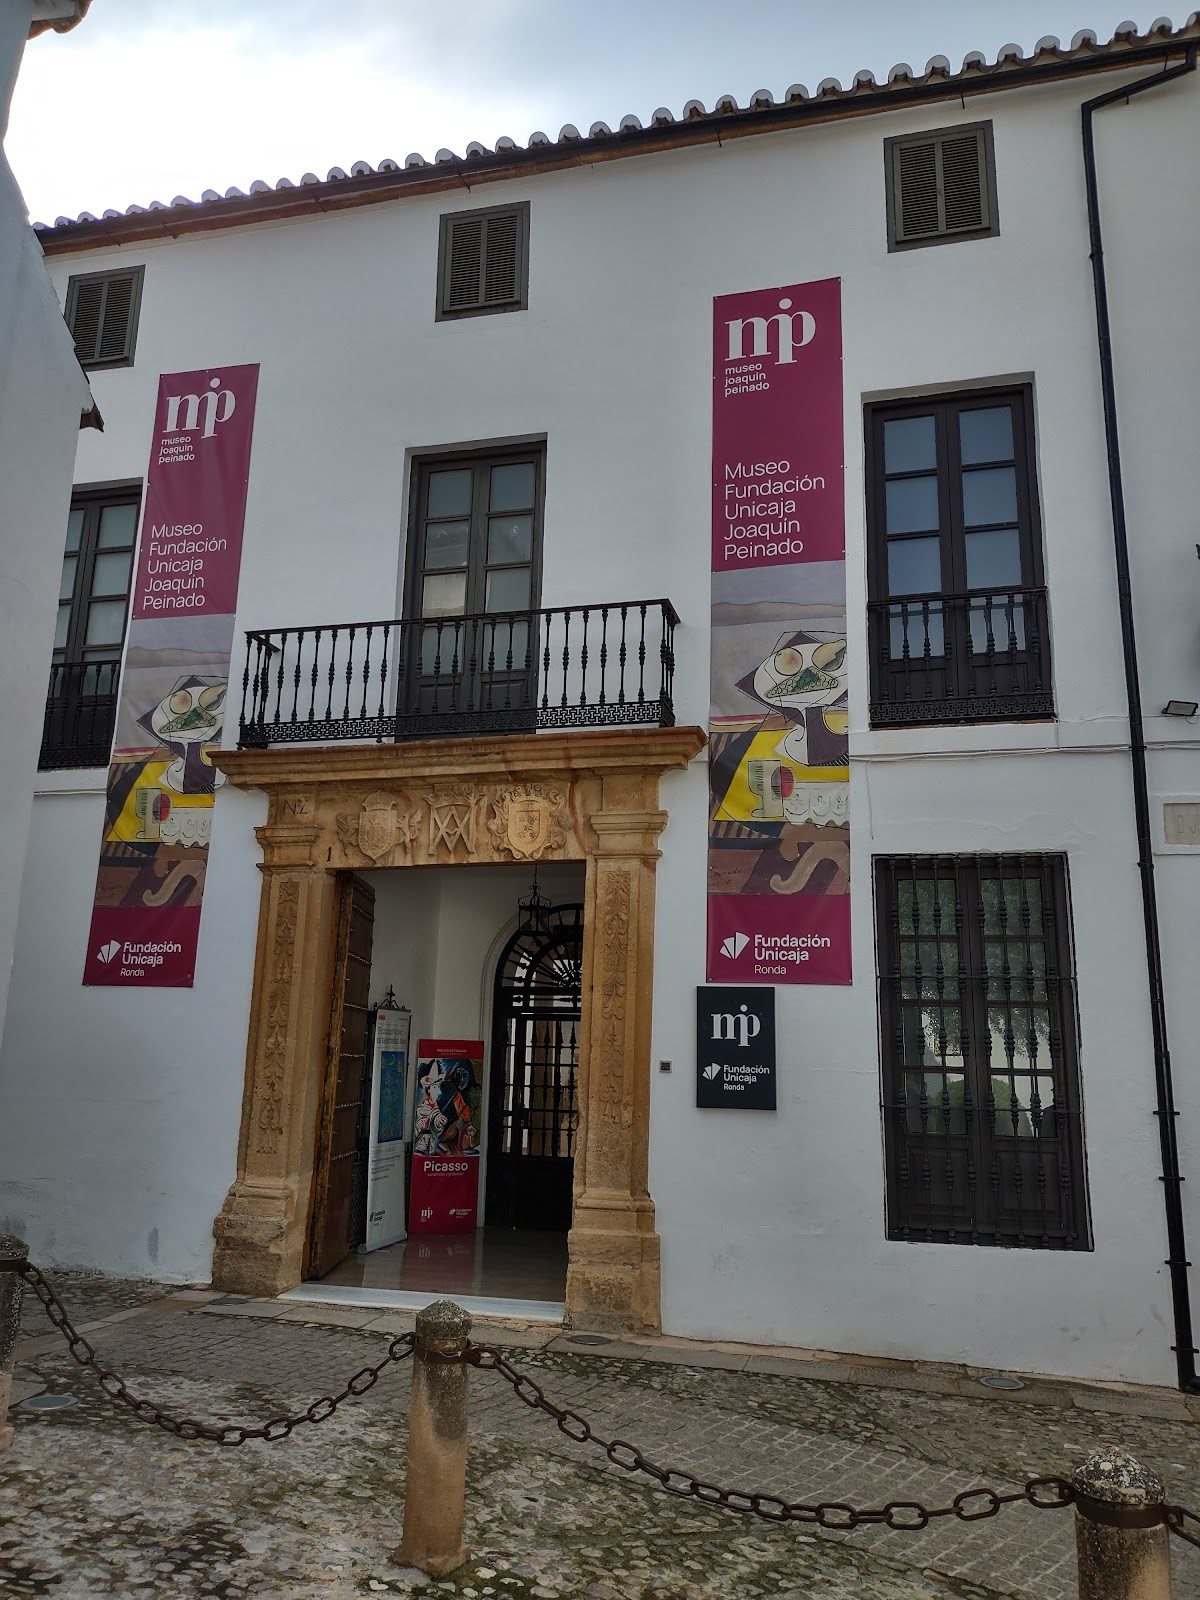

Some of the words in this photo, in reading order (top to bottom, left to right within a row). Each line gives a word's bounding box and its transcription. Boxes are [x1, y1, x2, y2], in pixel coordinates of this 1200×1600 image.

[725, 363, 763, 375] museo
[725, 381, 770, 398] peinado
[161, 436, 191, 446] museo
[158, 453, 195, 465] peinado
[725, 460, 790, 481] Museo
[725, 475, 825, 500] Fundación
[725, 497, 796, 520] Unicaja
[151, 523, 203, 539] Museo
[723, 517, 800, 541] Joaquín
[149, 537, 227, 557] Fundación
[724, 538, 804, 561] Peinado
[147, 556, 204, 575] Unicaja
[144, 574, 205, 594] Joaquín
[142, 592, 206, 611] Peinado
[123, 941, 182, 953] Fundación
[754, 934, 831, 948] Fundación
[122, 953, 164, 968] Unicaja
[754, 948, 810, 965] Unicaja
[120, 967, 145, 977] Ronda
[754, 964, 787, 975] Ronda
[723, 1064, 770, 1075] Fundación
[723, 1073, 757, 1084] Unicaja
[723, 1083, 745, 1091] Ronda
[423, 1161, 469, 1172] Picasso
